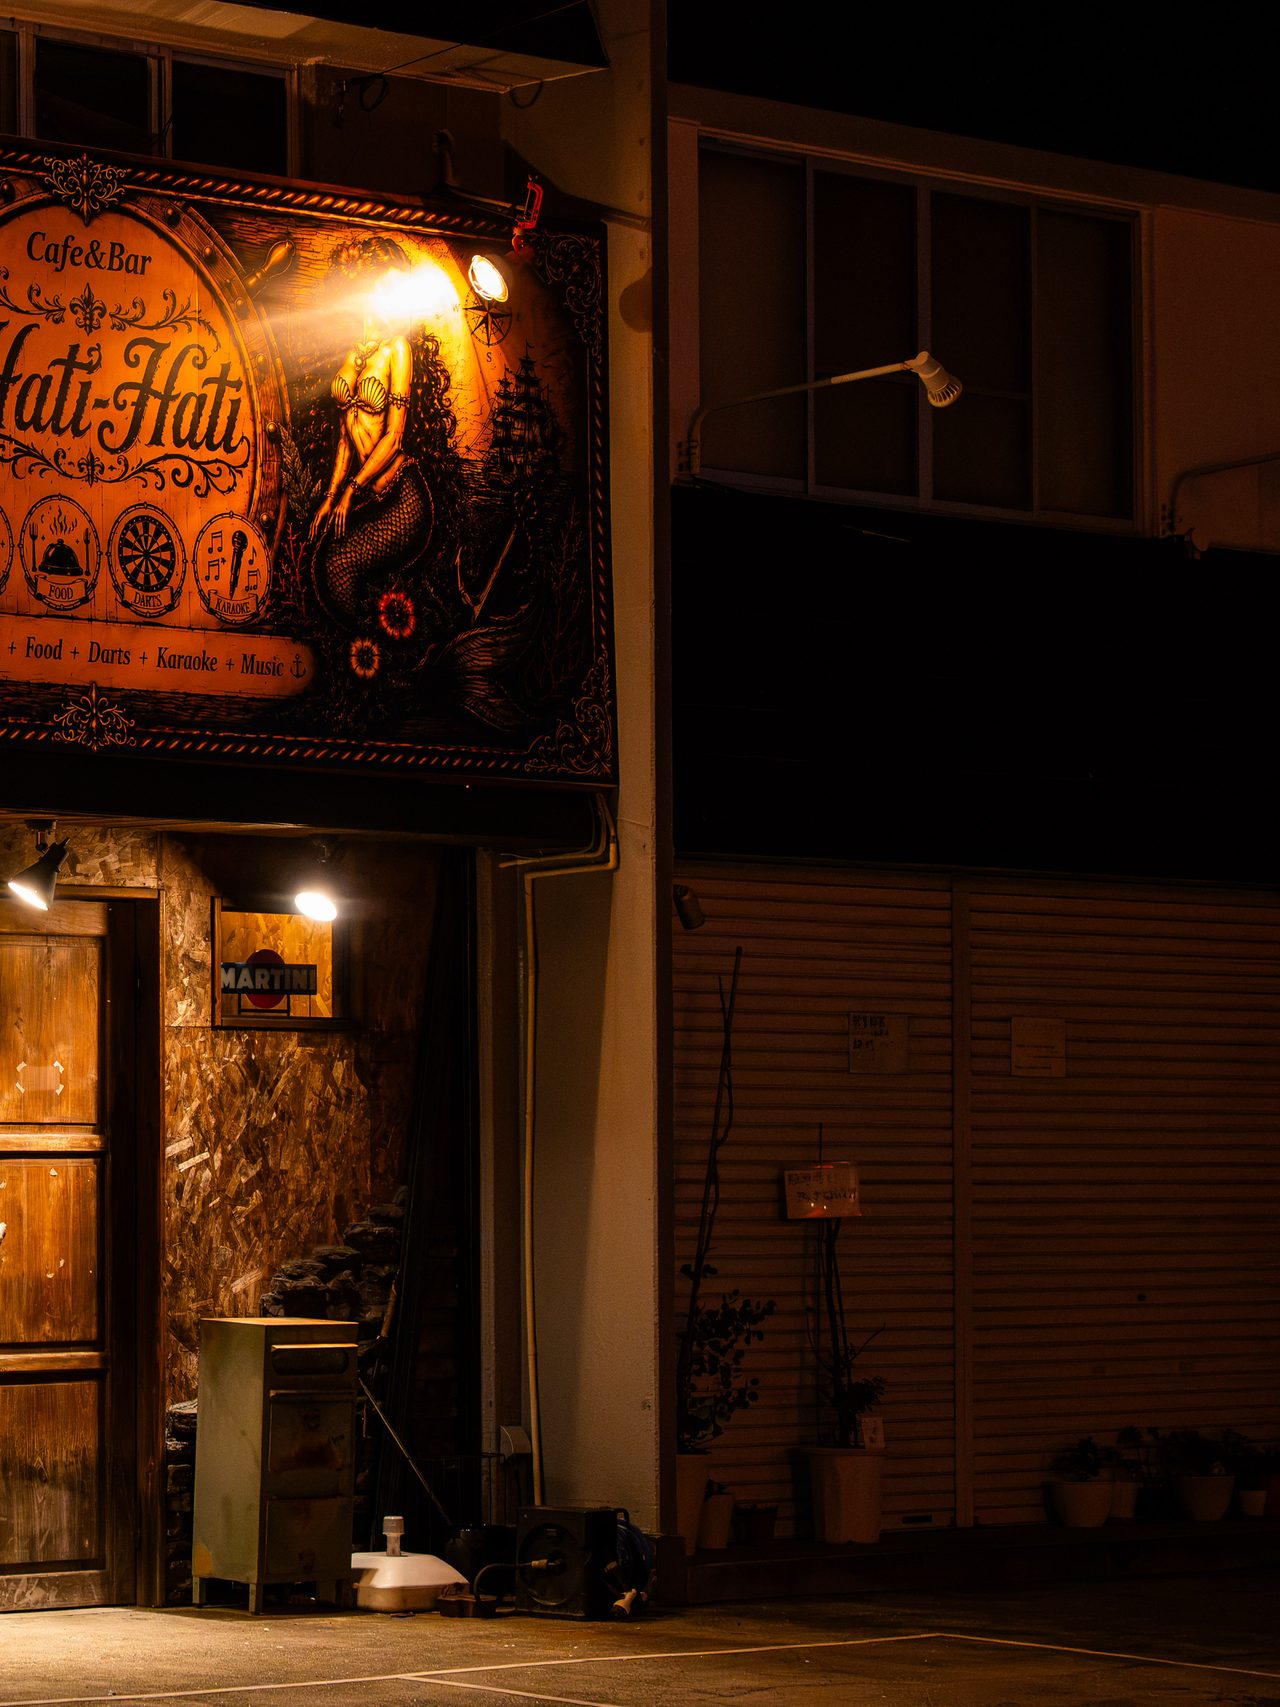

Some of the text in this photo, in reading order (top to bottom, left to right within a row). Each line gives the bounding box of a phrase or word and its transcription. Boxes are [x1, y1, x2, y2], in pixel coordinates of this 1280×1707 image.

[26, 231, 152, 276] Cafe&Bar
[48, 585, 74, 600] FOOD
[133, 593, 163, 608] DARTS
[216, 599, 251, 615] KARAOKE
[25, 636, 63, 660] Food
[88, 641, 131, 666] Darts
[156, 646, 218, 672] Karaoke
[241, 653, 285, 677] Music
[221, 967, 315, 990] MARTINI
